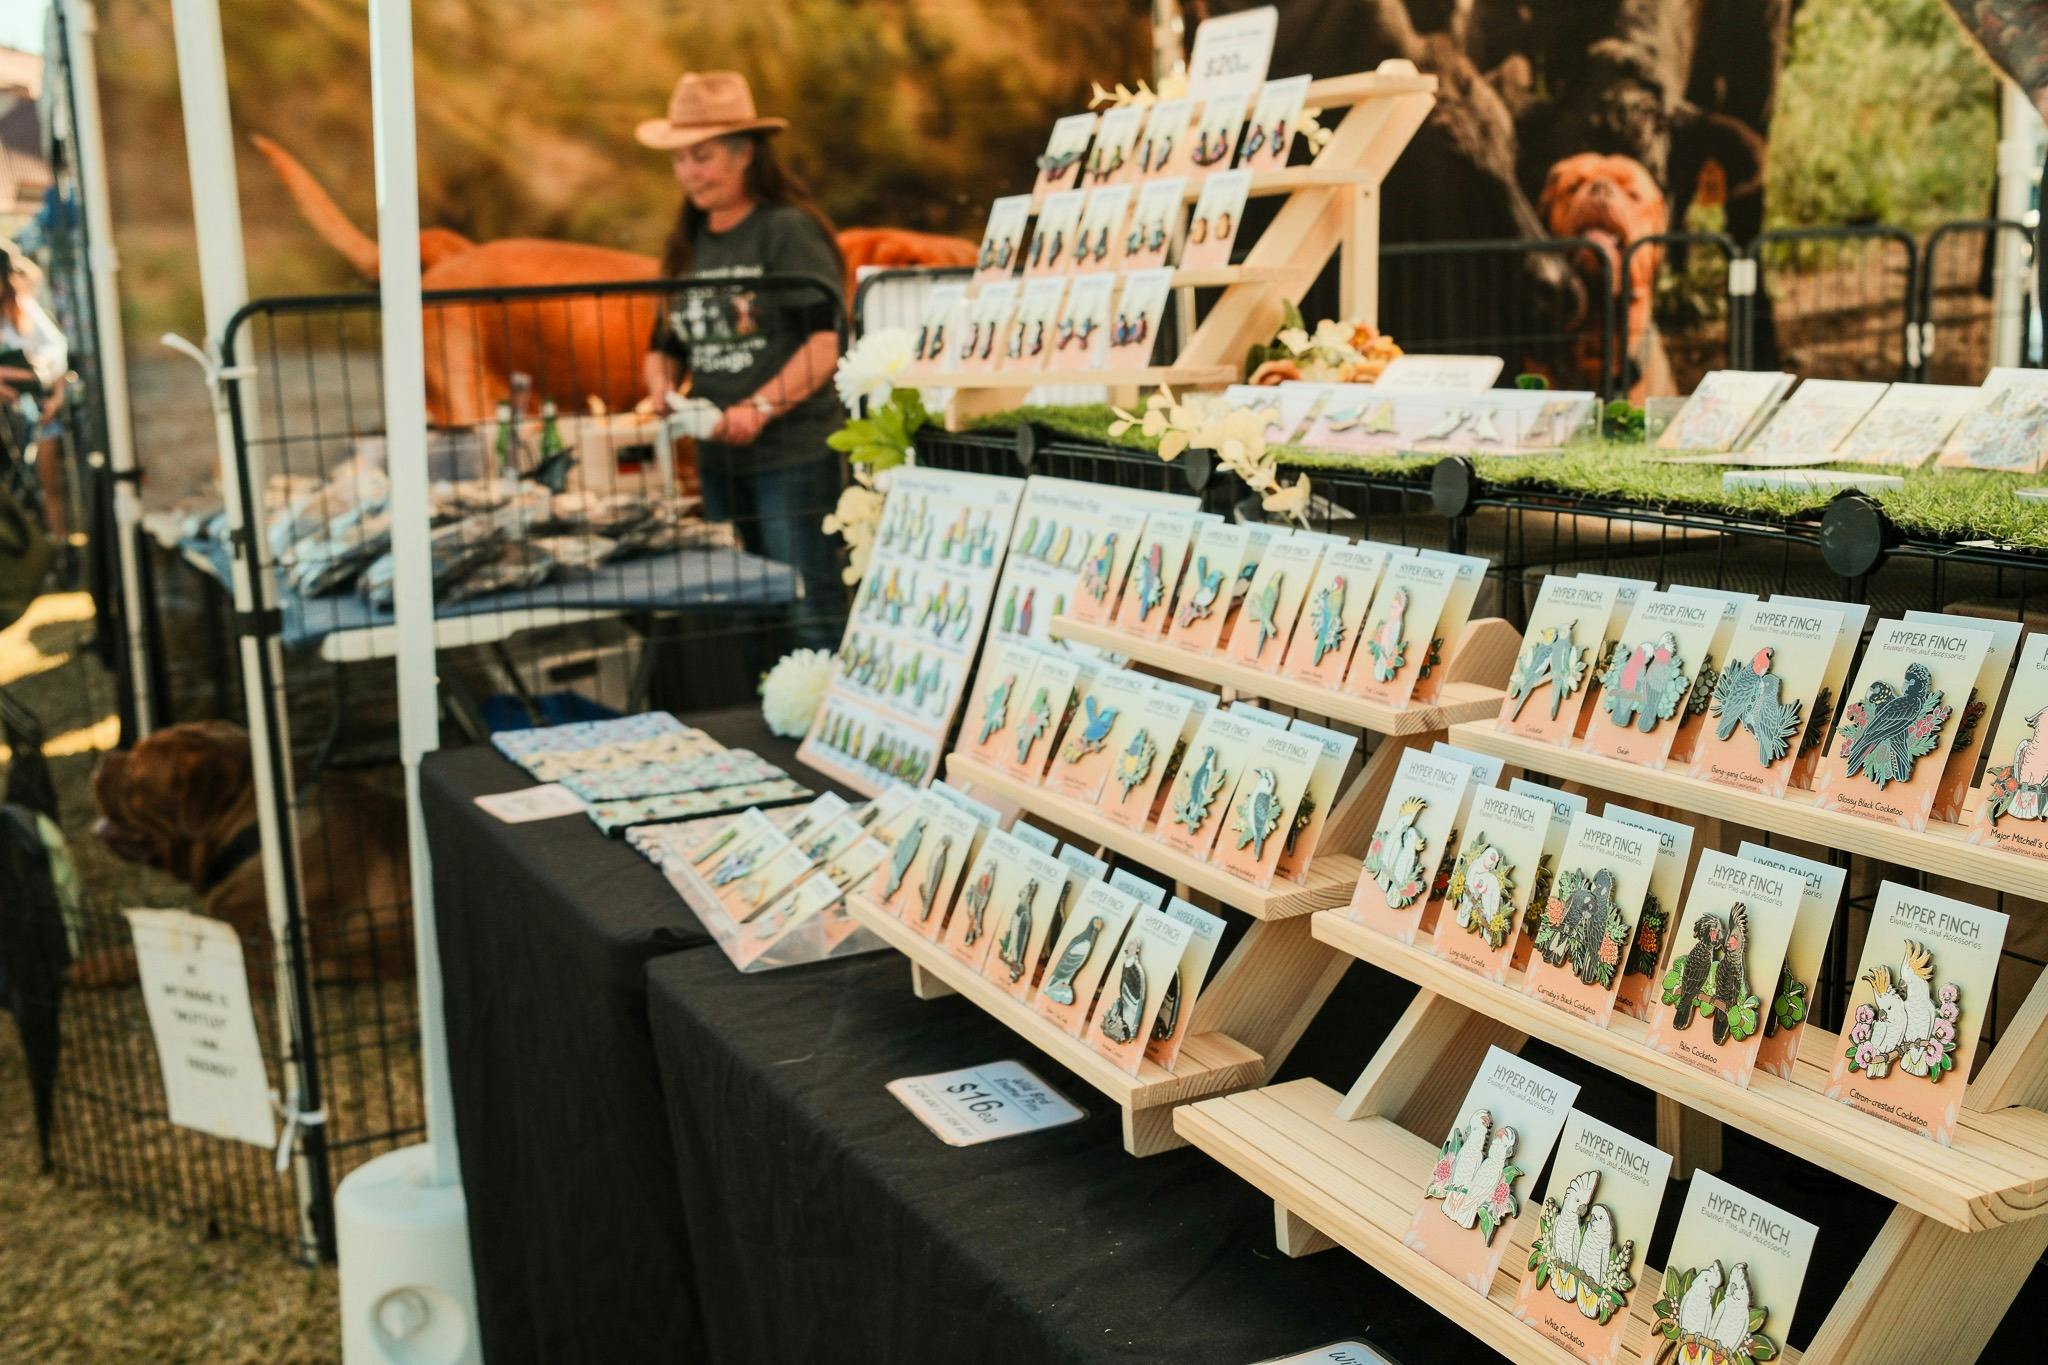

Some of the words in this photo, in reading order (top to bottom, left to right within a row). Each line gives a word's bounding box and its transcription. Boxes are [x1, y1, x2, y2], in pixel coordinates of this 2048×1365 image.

[1400, 564, 1421, 576] HYPER
[1421, 566, 1444, 580] FINCH
[1552, 586, 1576, 600] HYPER
[1577, 589, 1603, 602] FINCH
[1647, 603, 1676, 616] HYPER
[1677, 606, 1708, 622] FINCH
[1756, 612, 1788, 627] HYPER
[1788, 616, 1822, 632] FINCH
[1890, 630, 1926, 648] HYPER
[1928, 634, 1968, 652] FINCH
[1930, 650, 1966, 661] Accessories
[1409, 762, 1434, 780] HYPER
[1434, 768, 1457, 786] FINCH
[1740, 771, 1764, 784] Cockatoo
[1483, 797, 1508, 816] HYPER
[1510, 804, 1535, 824] FINCH
[1837, 794, 1858, 808] Glossy
[1858, 797, 1874, 809] Black
[1874, 802, 1904, 816] Cockatoo
[1584, 827, 1612, 846] HYPER
[1613, 836, 1642, 856] FINCH
[1990, 828, 2010, 842] Major
[1714, 864, 1748, 886] HYPER
[1748, 874, 1784, 896] FINCH
[1752, 891, 1783, 906] Accessories
[1896, 900, 1936, 926] HYPER
[1938, 914, 1980, 939] FINCH
[1889, 916, 1913, 928] Enamel
[1914, 923, 1927, 934] Pins
[1928, 929, 1942, 938] and
[1942, 932, 1982, 950] Accessories
[1574, 1000, 1596, 1016] Cockatoo
[1679, 1040, 1691, 1053] Palm
[1691, 1046, 1718, 1064] Cockatoo
[1494, 1064, 1526, 1090] HYPER
[1524, 1080, 1558, 1106] FINCH
[1849, 1088, 1896, 1114] Citron-crested
[1896, 1107, 1928, 1127] Cockatoo
[1580, 1128, 1614, 1158] HYPER
[1614, 1146, 1650, 1176] FINCH
[1618, 1164, 1650, 1186] Accessories
[1708, 1192, 1748, 1224] HYPER
[1748, 1212, 1790, 1246] FINCH
[1701, 1206, 1724, 1222] Enamel
[1752, 1234, 1791, 1258] Accessories
[1544, 1314, 1560, 1332] White
[1560, 1325, 1585, 1348] Cockatoo
